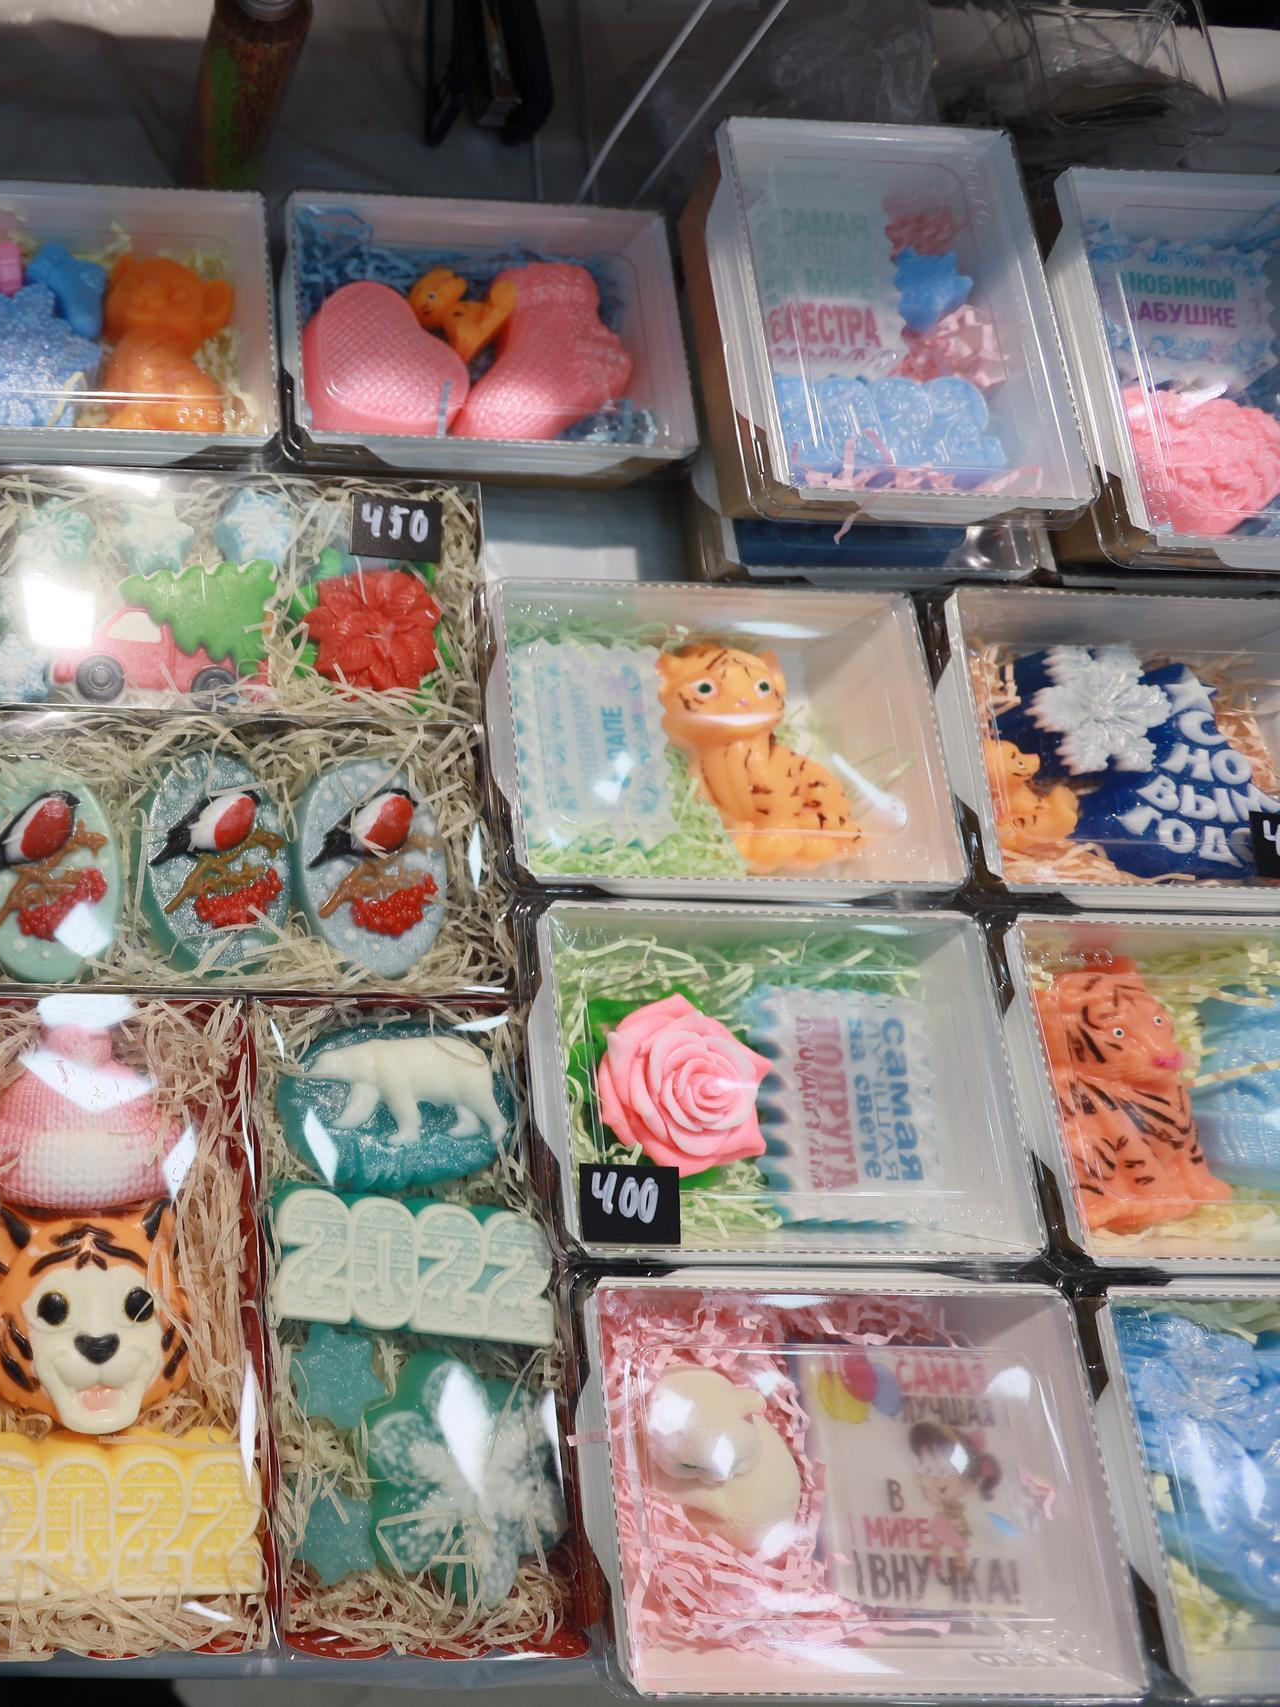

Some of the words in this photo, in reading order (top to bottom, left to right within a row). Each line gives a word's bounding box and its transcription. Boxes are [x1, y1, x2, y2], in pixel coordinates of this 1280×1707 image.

[361, 502, 429, 542] 450
[1179, 710, 1228, 746] С
[1159, 742, 1252, 786] НО
[1136, 774, 1280, 823] ВЫМ
[592, 1171, 659, 1223] 400
[271, 1188, 556, 1346] 2022
[885, 1478, 905, 1513] В
